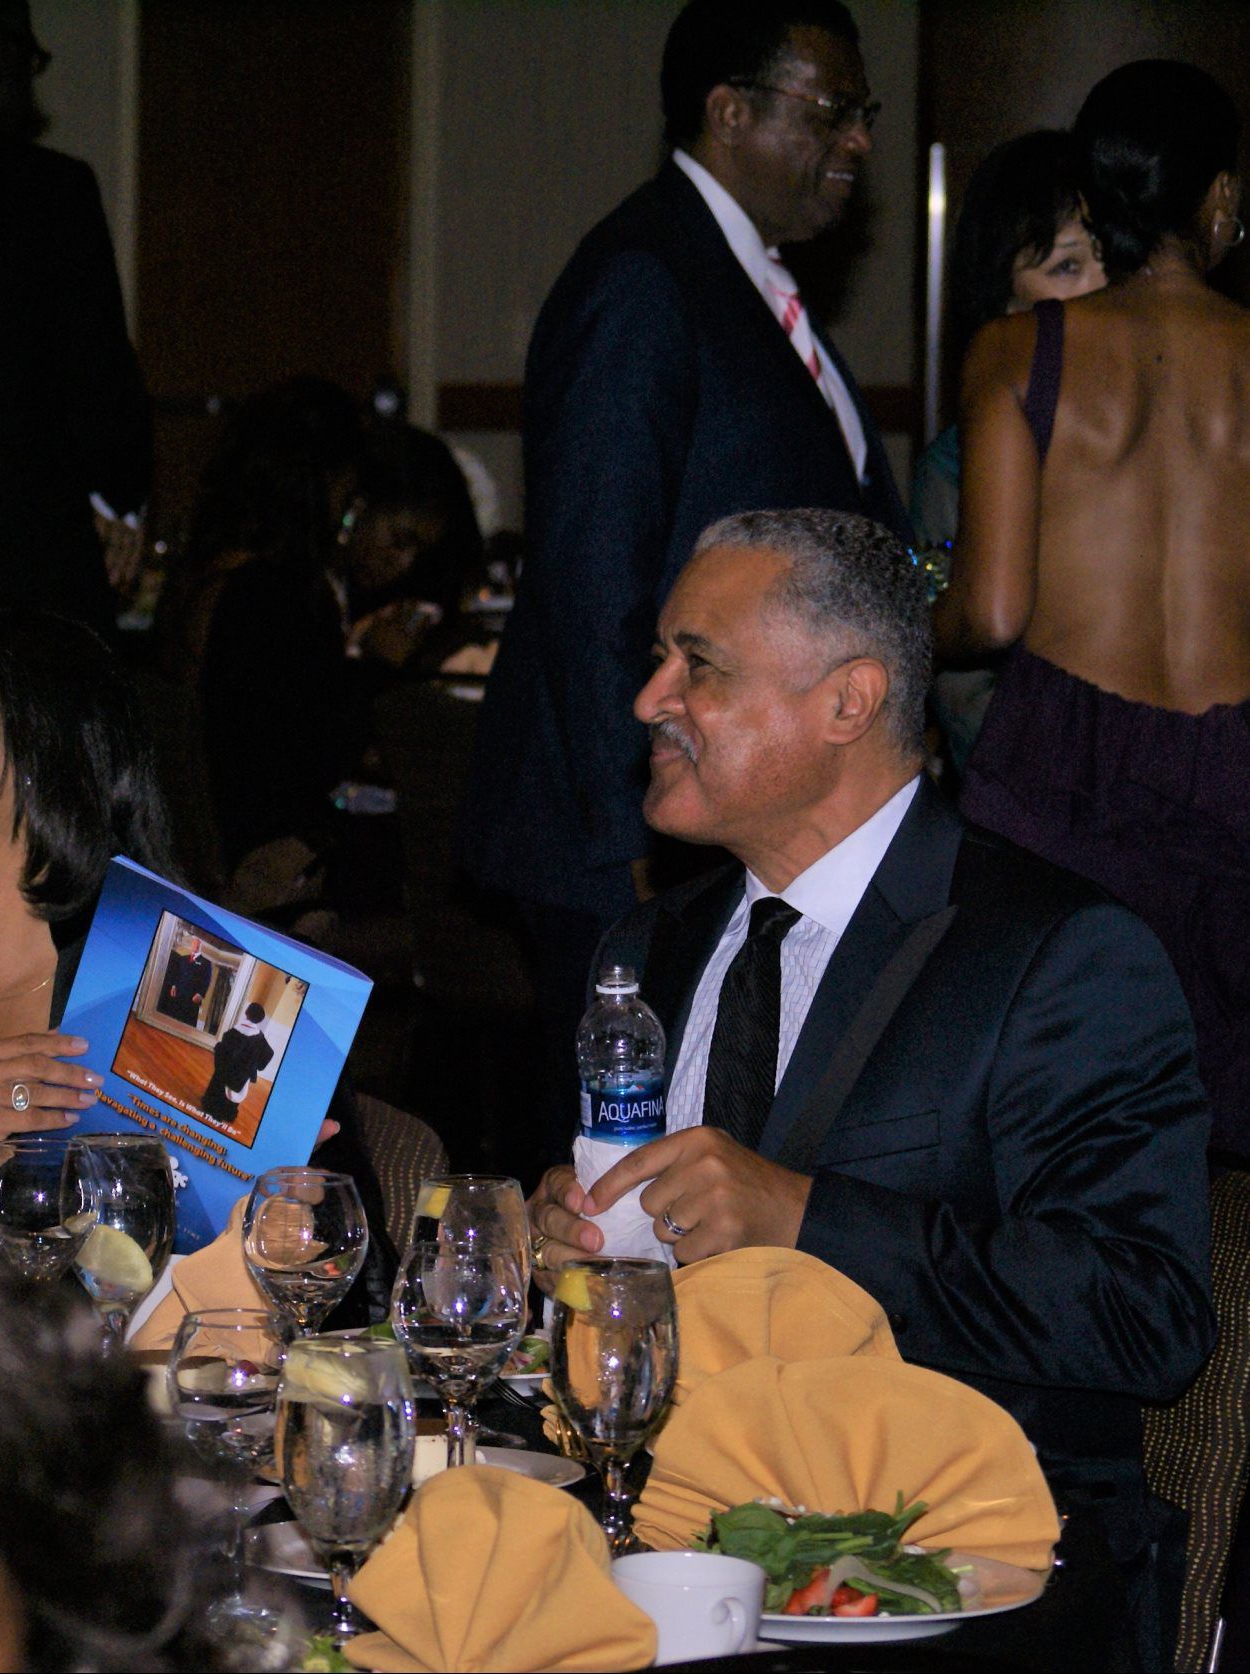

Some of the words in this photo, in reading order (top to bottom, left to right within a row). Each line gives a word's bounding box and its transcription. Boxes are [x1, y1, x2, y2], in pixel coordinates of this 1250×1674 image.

[148, 1081, 164, 1095] They
[185, 1103, 203, 1118] What
[598, 1095, 665, 1123] AQUAFINA
[94, 1088, 150, 1130] Navagating
[148, 1121, 157, 1131] a
[159, 1127, 218, 1167] challenging
[161, 1113, 177, 1129] are
